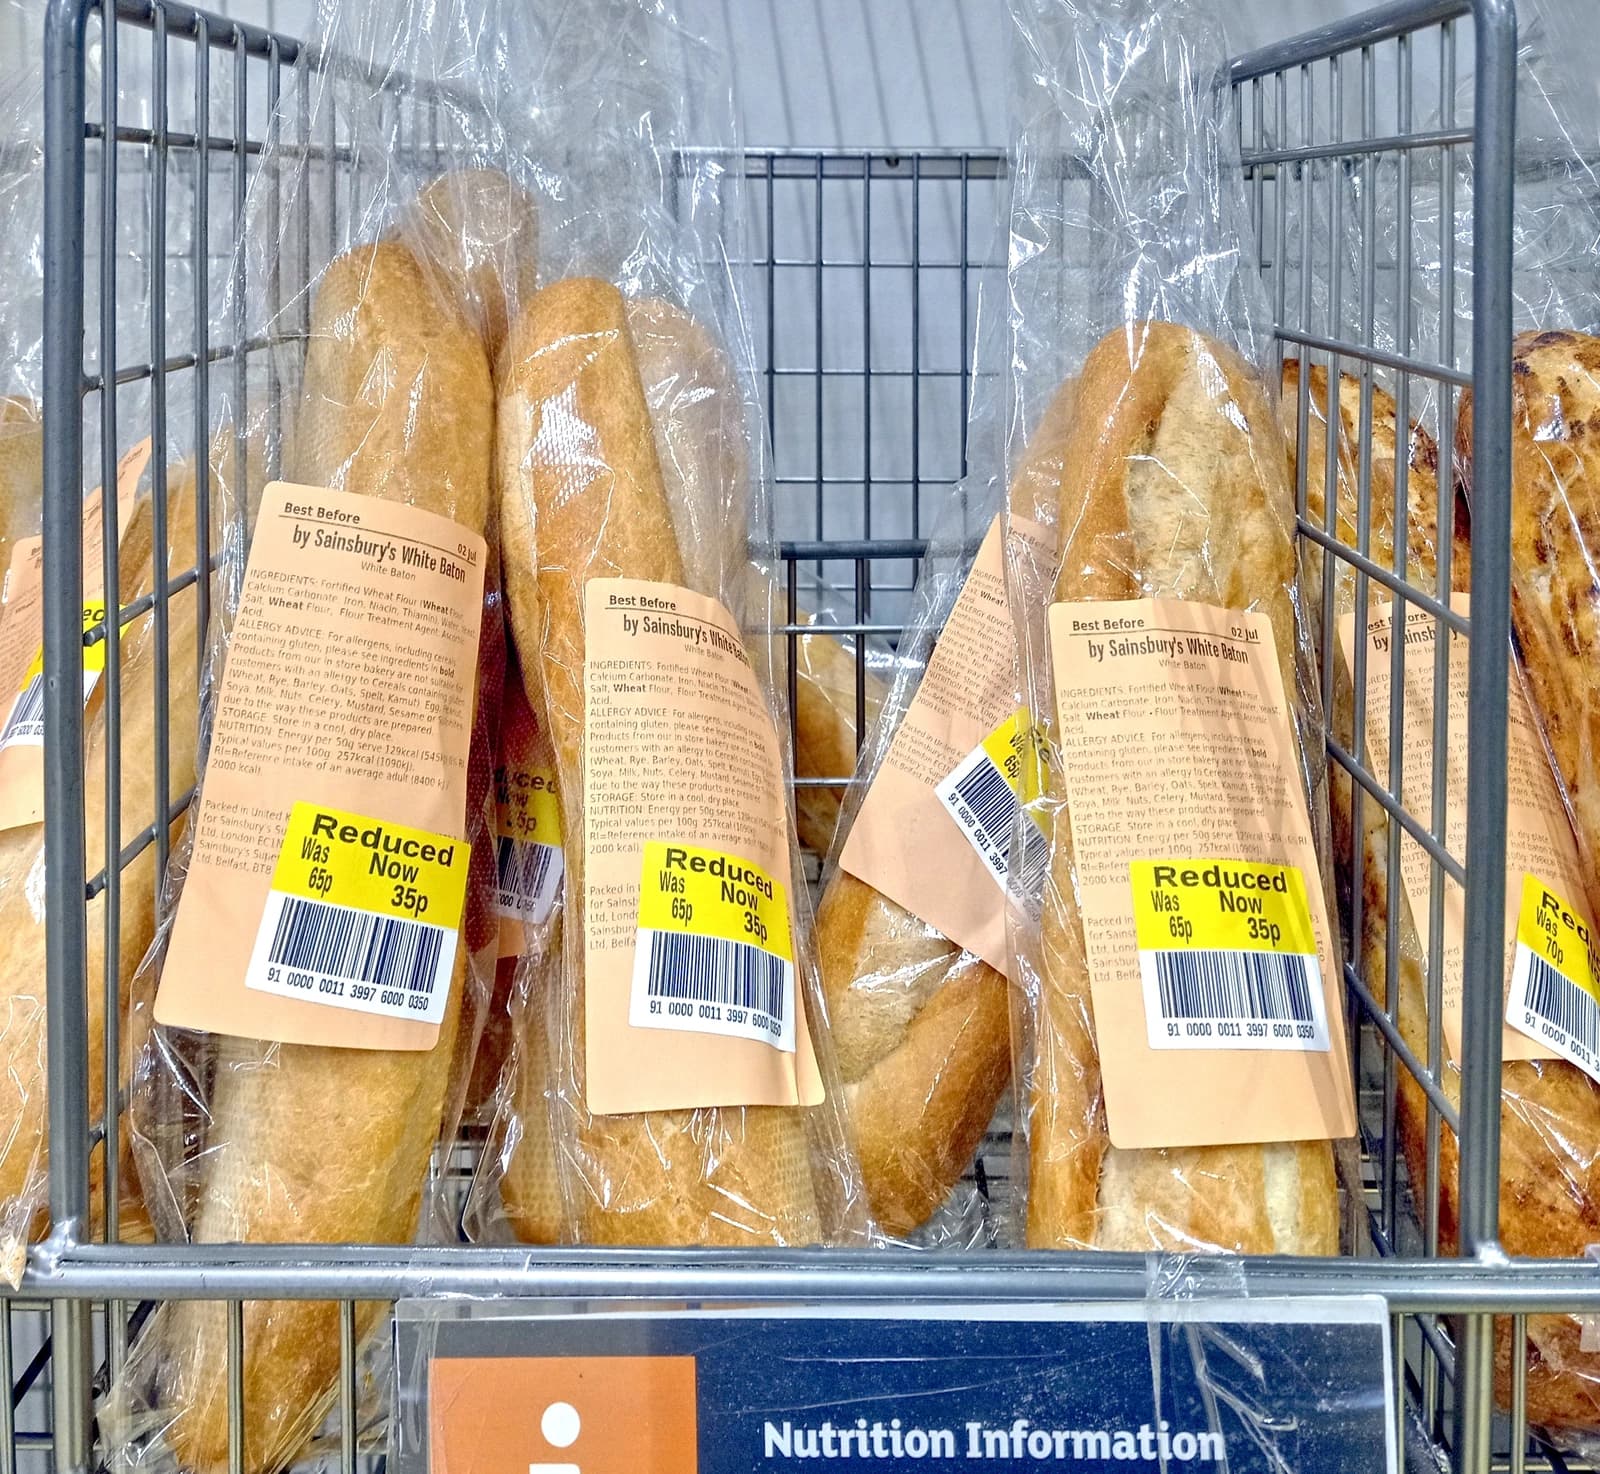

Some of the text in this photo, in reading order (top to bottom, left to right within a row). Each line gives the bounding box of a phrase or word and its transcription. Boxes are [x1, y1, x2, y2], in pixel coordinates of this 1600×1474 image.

[284, 502, 361, 526] Best Before
[292, 524, 467, 583] by Sainsbury's White Baton
[457, 543, 468, 558] 02
[361, 560, 417, 582] White Baton
[247, 581, 286, 595] Calcium
[363, 586, 394, 602] Wheat
[609, 594, 677, 611] Best Before
[268, 596, 303, 611] Wheat
[339, 607, 364, 621] Flour
[366, 612, 413, 632] Treatment
[1072, 617, 1145, 632] Best Before
[239, 618, 283, 633] ALLERGY
[328, 631, 345, 643] For
[623, 614, 639, 637] by
[643, 615, 708, 645] Sainsbury's
[708, 629, 734, 654] White
[1231, 626, 1260, 642] 02 Jul
[1372, 635, 1389, 652] by
[1087, 635, 1250, 665] by Sainsbury's White Baton
[361, 651, 378, 663] see
[439, 666, 455, 680] bold
[363, 664, 395, 682] bakery
[1182, 659, 1208, 671] Baton
[613, 683, 646, 694] Wheat
[589, 707, 631, 718] ALLERGY
[1086, 710, 1121, 721] Wheat
[349, 727, 365, 741] dry
[311, 813, 456, 869] Reduced
[947, 792, 1009, 875] 91 0000 0011 3997
[300, 836, 331, 864] Was
[367, 852, 421, 884] Now
[665, 846, 774, 901] Reduced
[307, 866, 429, 918] 65p 35p
[659, 870, 760, 912] Was Now
[1153, 865, 1288, 894] Reduced
[1150, 889, 1264, 915] Was Now
[671, 896, 768, 945] 65p 35p
[1168, 915, 1281, 948] 65p 35p
[1535, 905, 1558, 938] Was
[1546, 936, 1564, 968] 70p
[266, 966, 430, 1012] 91 0000 0011 3997 6000 0350
[650, 1000, 663, 1015] 91
[668, 1002, 694, 1018] 0000
[699, 1006, 722, 1021] 0011
[726, 1008, 749, 1025] 3997
[752, 1012, 770, 1031] 6000
[1166, 1022, 1315, 1040] 91 0000 0011 3997 6000 0350
[1524, 1012, 1536, 1029] 91
[1541, 1022, 1567, 1047] 0000
[1570, 1039, 1592, 1066] 0011
[762, 1418, 1226, 1463] Nutrition Information
